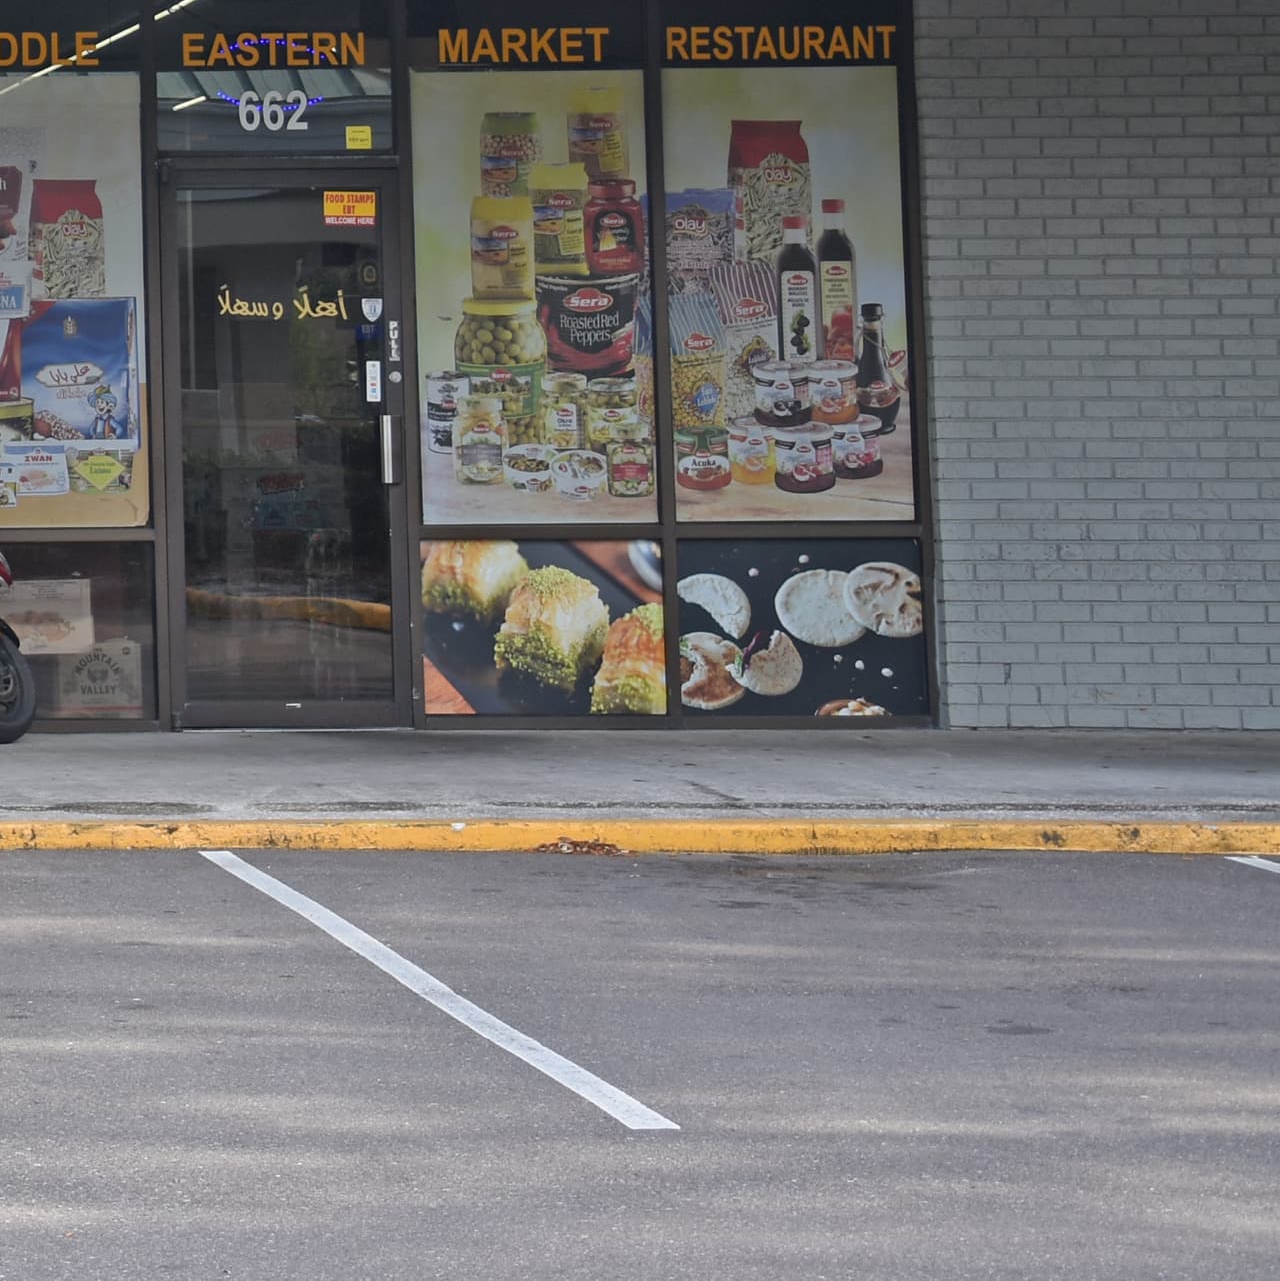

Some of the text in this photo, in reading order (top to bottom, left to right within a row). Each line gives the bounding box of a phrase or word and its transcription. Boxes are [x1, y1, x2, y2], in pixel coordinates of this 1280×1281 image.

[182, 31, 365, 67] EASTERN
[439, 27, 609, 63] MARKET
[666, 25, 897, 61] RESTAURANT
[239, 90, 309, 132] 662
[325, 193, 374, 205] FOOD STAMPS
[342, 205, 356, 215] EBT
[325, 216, 375, 225] WELCOME HERE
[675, 217, 706, 233] olay
[569, 296, 609, 307] Sera
[735, 304, 764, 317] Sera
[559, 311, 620, 330] Roasted Red
[571, 329, 611, 347] Peppers
[688, 338, 713, 348] Sera
[691, 458, 716, 468] Acuka
[75, 653, 120, 676] MOUNTAIN
[80, 684, 118, 695] VALLEY
